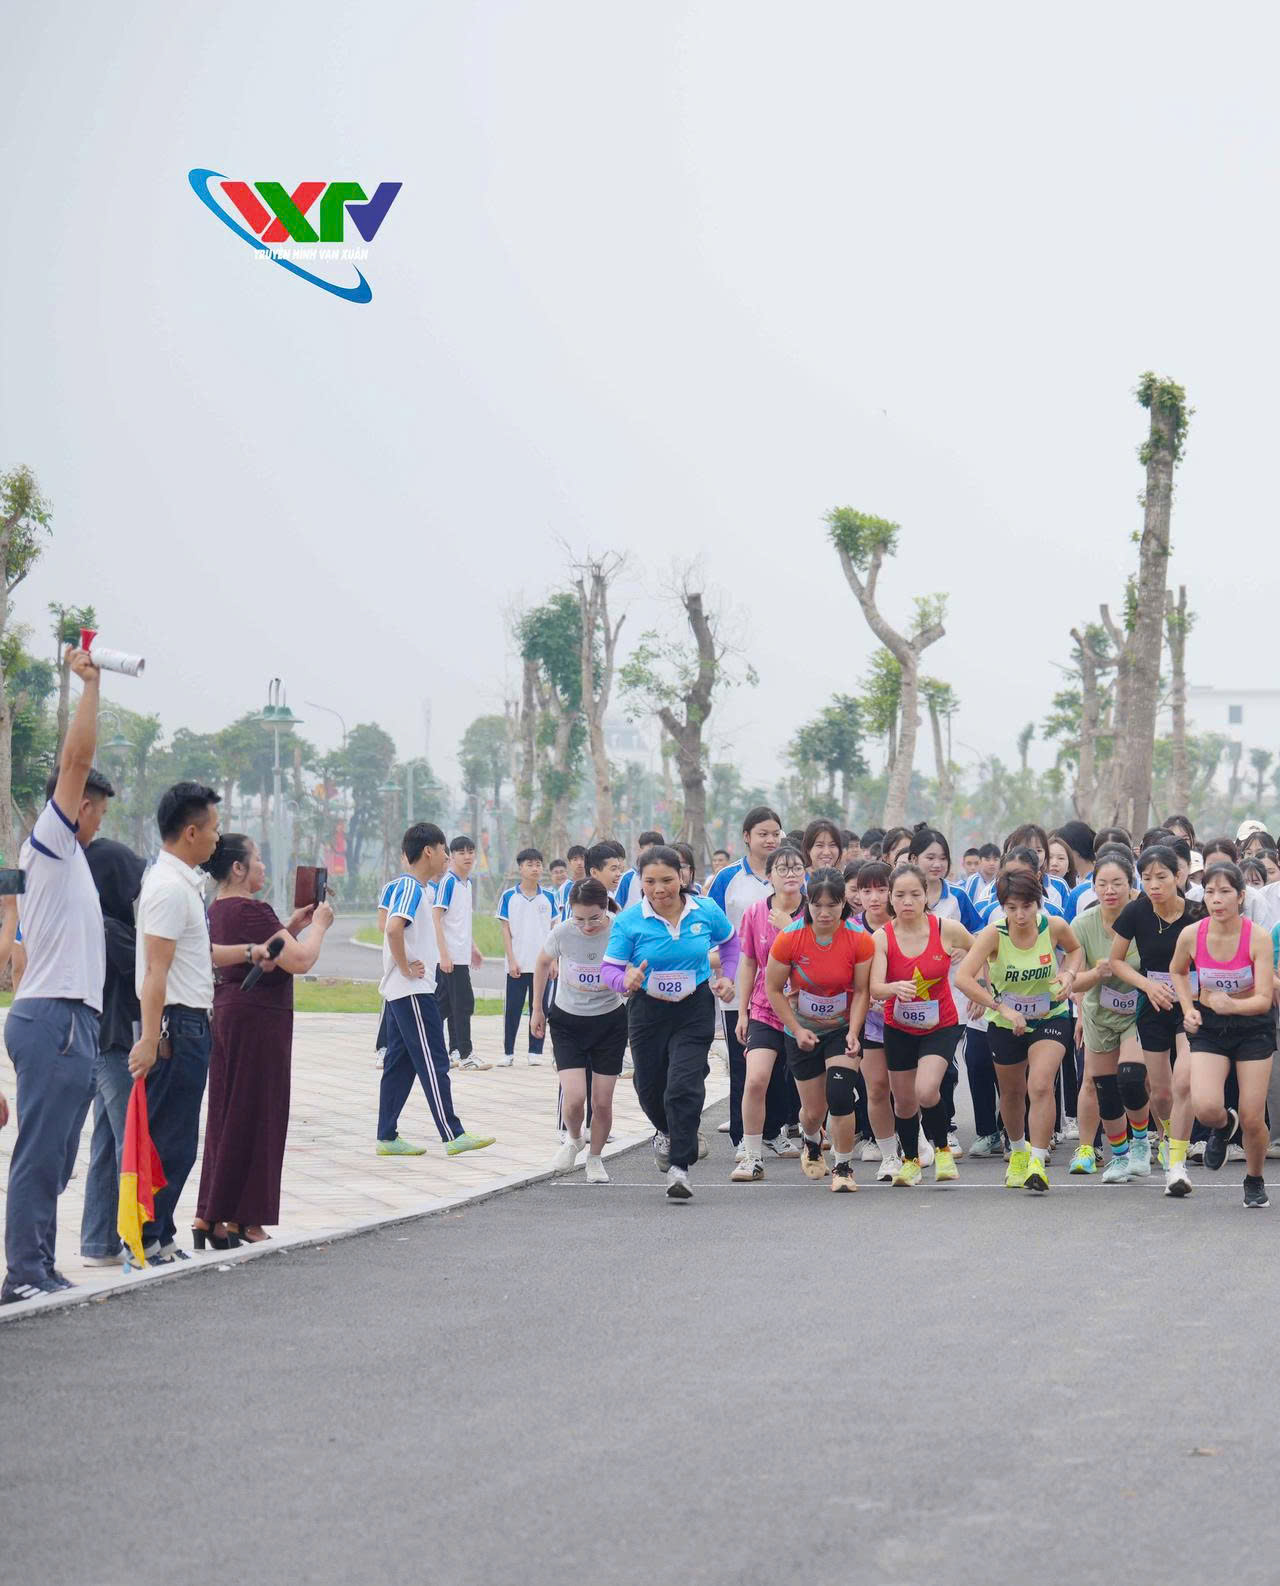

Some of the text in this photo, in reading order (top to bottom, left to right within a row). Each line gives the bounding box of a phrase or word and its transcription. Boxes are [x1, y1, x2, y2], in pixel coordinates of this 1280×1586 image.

[578, 973, 600, 983] 001
[1005, 965, 1052, 982] PR SPORT
[658, 982, 682, 993] 028
[1215, 980, 1239, 989] 031
[811, 1003, 834, 1013] 082
[1014, 1003, 1036, 1012] 011
[1112, 998, 1135, 1009] 069
[902, 1011, 926, 1021] 085
